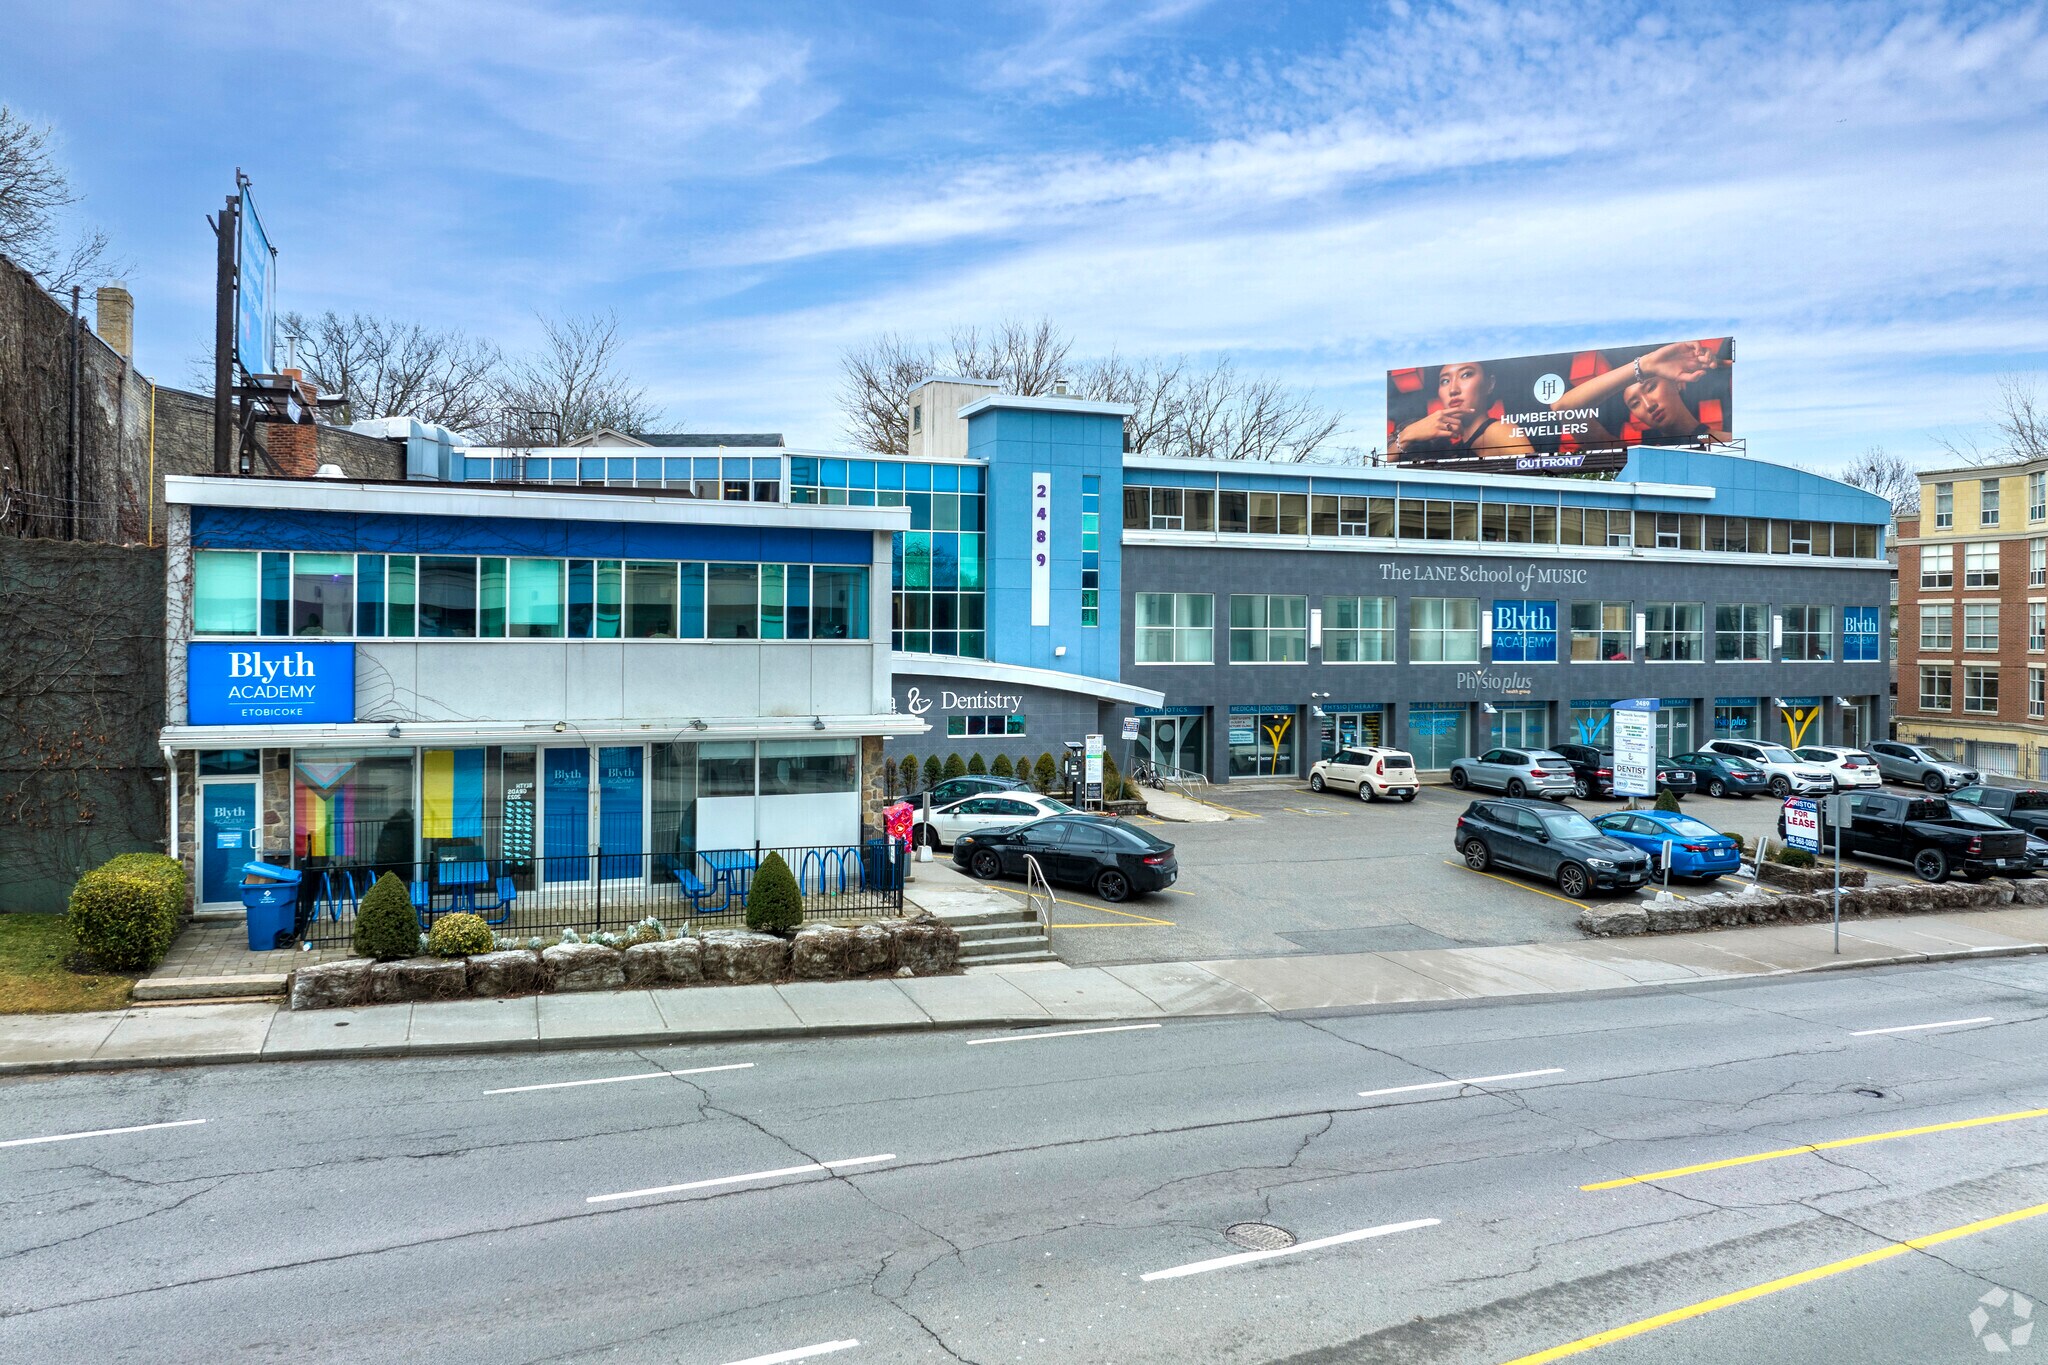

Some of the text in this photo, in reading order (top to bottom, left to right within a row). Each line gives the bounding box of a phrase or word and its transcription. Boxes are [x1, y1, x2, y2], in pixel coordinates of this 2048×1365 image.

[1500, 408, 1599, 425] HUMBERTOWN
[1509, 423, 1588, 438] JEWELLERS
[1036, 484, 1047, 567] 2489
[1379, 562, 1587, 592] The LANE School of MUSIC
[1496, 607, 1551, 636] Blyth
[1496, 636, 1552, 648] ACADEMY
[228, 651, 316, 684] Blyth
[228, 685, 316, 699] ACADEMY
[940, 690, 1023, 713] Dentistry
[241, 708, 303, 717] ETOBICOKE
[554, 769, 581, 782] Blyth
[608, 767, 635, 780] Blyth
[1616, 765, 1646, 775] DENTIST
[1787, 799, 1817, 810] ARISTON
[214, 806, 246, 819] Blyth
[1794, 810, 1808, 818] FOR
[1787, 816, 1816, 829] LEASE
